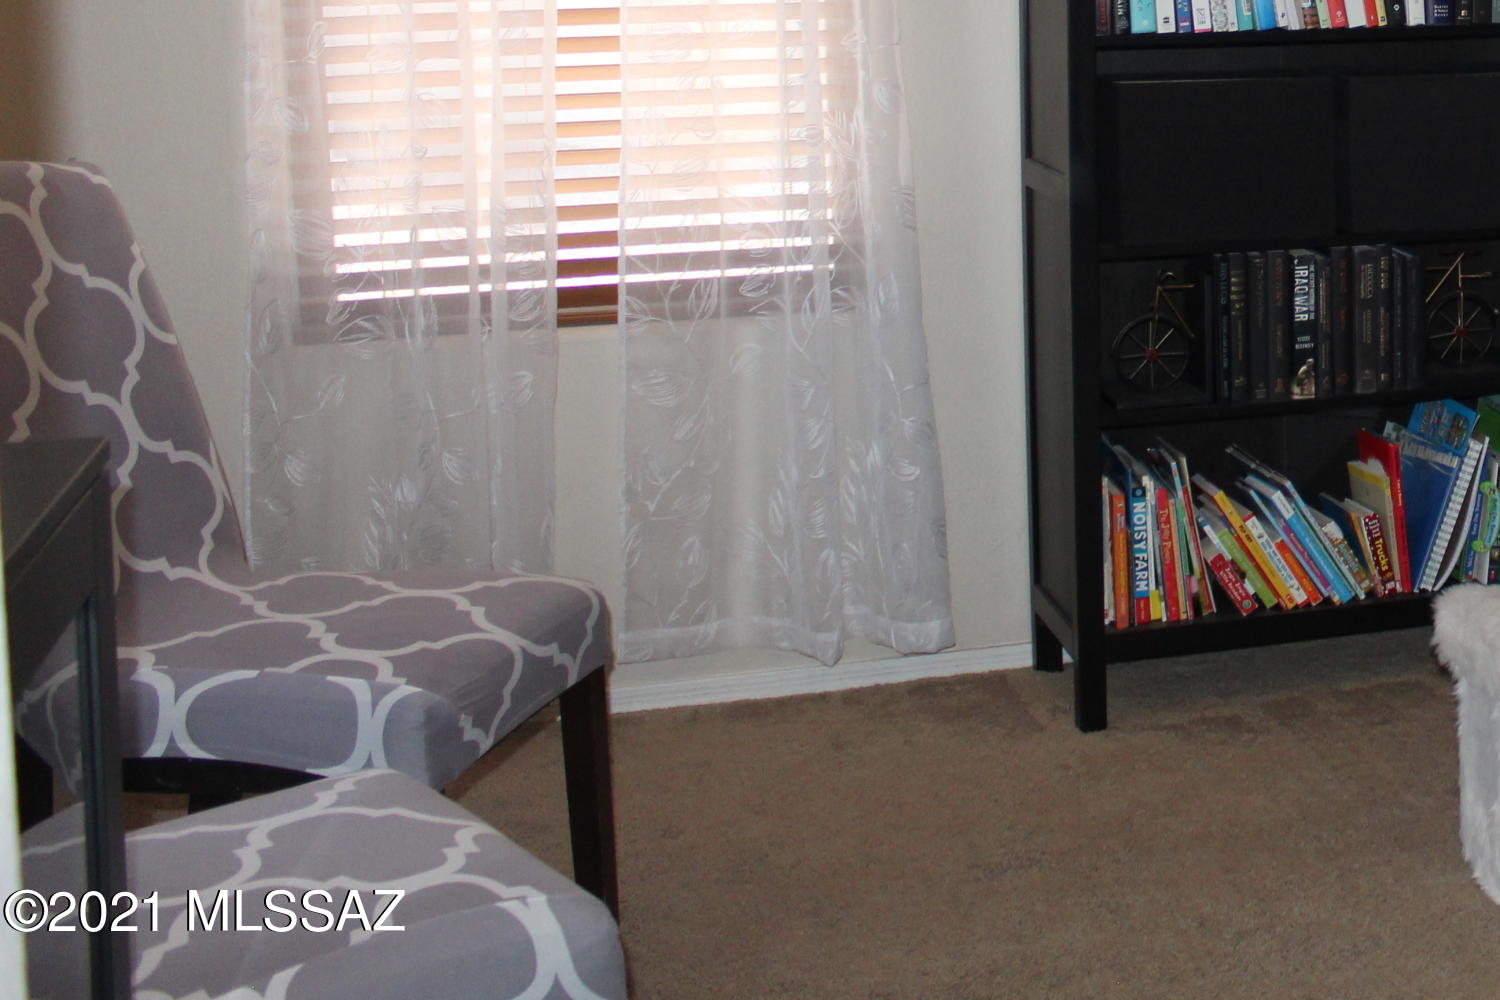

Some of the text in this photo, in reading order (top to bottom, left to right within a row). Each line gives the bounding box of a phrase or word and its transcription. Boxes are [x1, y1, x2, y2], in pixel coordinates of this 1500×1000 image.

[1293, 265, 1308, 322] IRAQ WAR
[1133, 502, 1148, 592] NOISY FARM
[1374, 539, 1388, 572] Trucks
